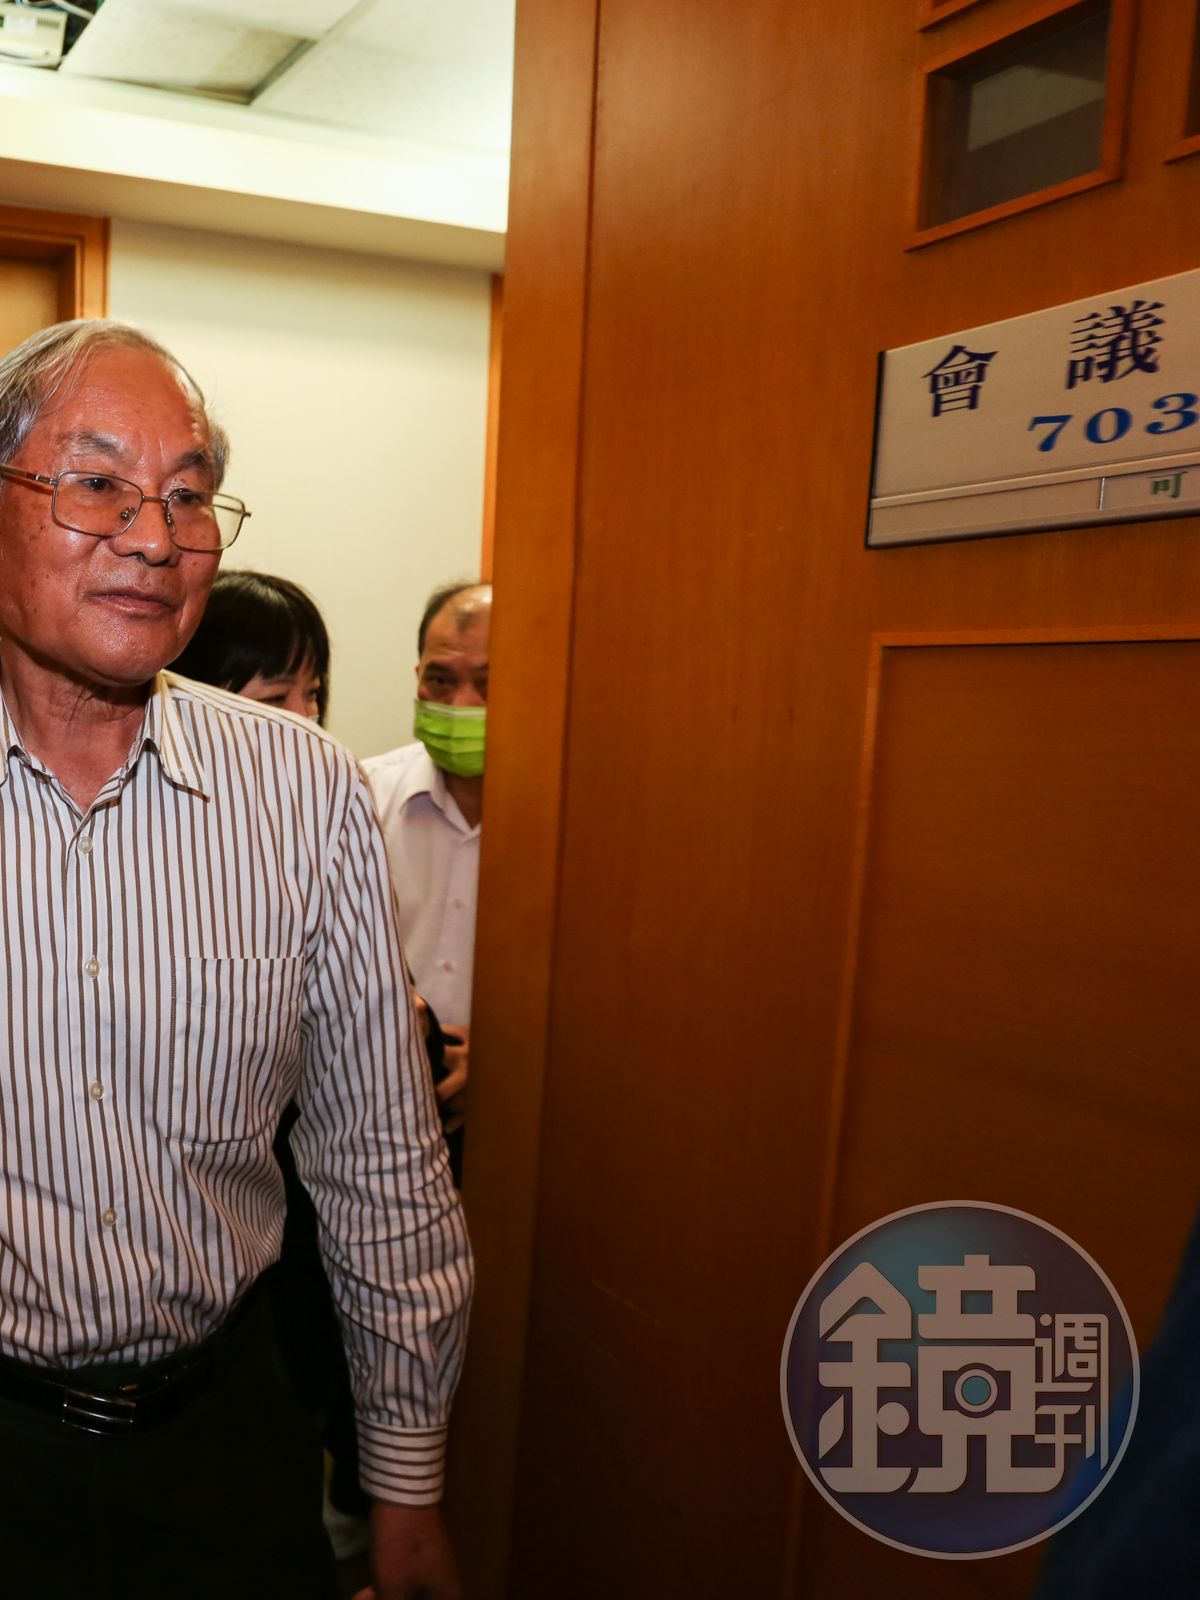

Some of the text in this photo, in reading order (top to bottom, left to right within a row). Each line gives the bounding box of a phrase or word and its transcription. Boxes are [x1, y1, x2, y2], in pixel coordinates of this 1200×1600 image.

[921, 300, 1166, 418] 會議
[1027, 392, 1200, 452] 703
[1150, 470, 1188, 499] 可
